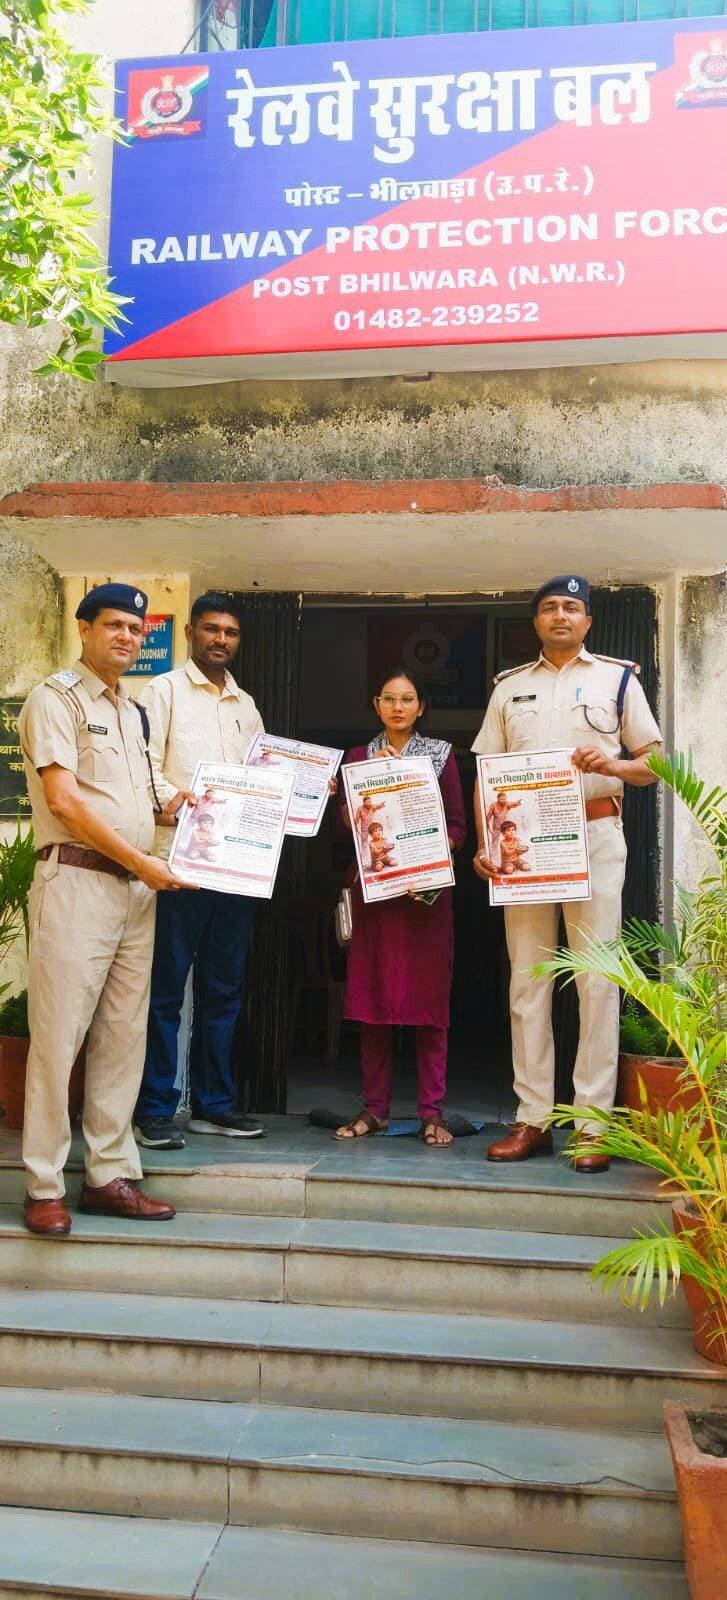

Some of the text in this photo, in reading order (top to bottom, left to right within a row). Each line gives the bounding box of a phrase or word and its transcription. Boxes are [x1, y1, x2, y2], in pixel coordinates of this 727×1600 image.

[226, 61, 656, 164] रेलवे सुरक्षा बल
[284, 181, 343, 208] पोस्ट
[369, 177, 477, 204] भीलवाड़ा
[484, 165, 595, 202] (उ.प.रे.)
[131, 206, 727, 265] RAILWAY PROTECTION FORC
[253, 260, 626, 299] POST BHILWARA (N.W.R.)
[334, 302, 540, 331] 01482-239252
[137, 647, 168, 661] HOUDHARY
